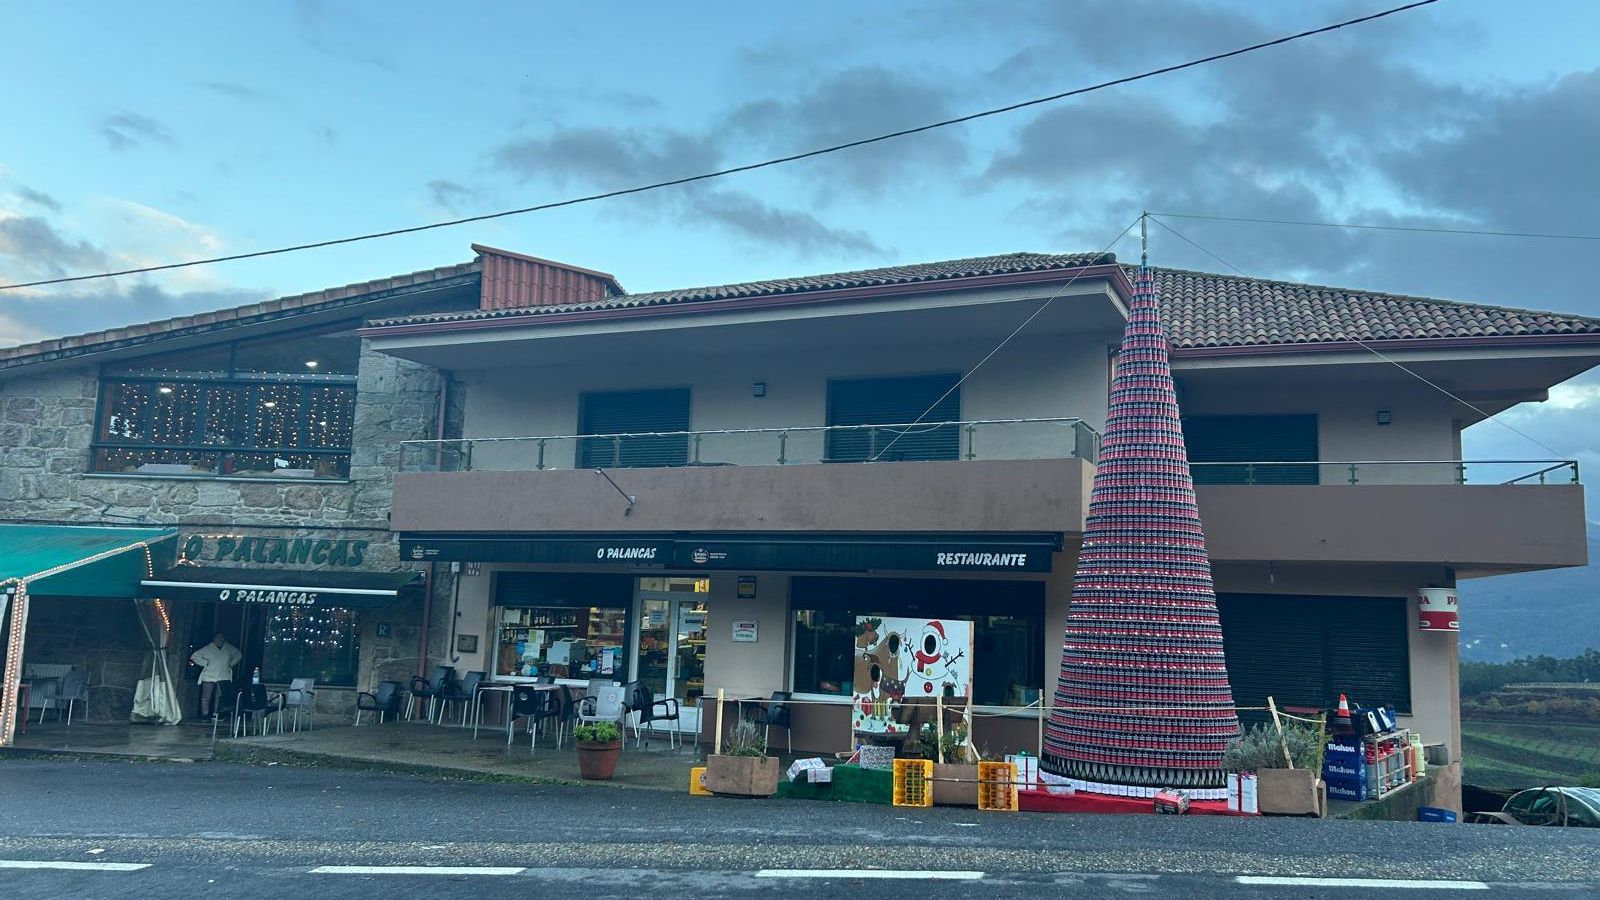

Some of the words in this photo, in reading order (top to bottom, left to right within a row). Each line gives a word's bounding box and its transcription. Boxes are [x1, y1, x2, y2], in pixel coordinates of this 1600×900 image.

[185, 537, 202, 559] O
[215, 537, 368, 566] PALANCAS
[597, 548, 604, 558] O
[607, 547, 656, 558] PALANCAS
[937, 553, 1026, 566] RESTAURANTE
[219, 589, 230, 600] O
[237, 590, 317, 605] PALANCAS
[1328, 743, 1355, 753] Mahou
[1328, 765, 1355, 774] Mahou
[1329, 786, 1356, 796] Mahou
